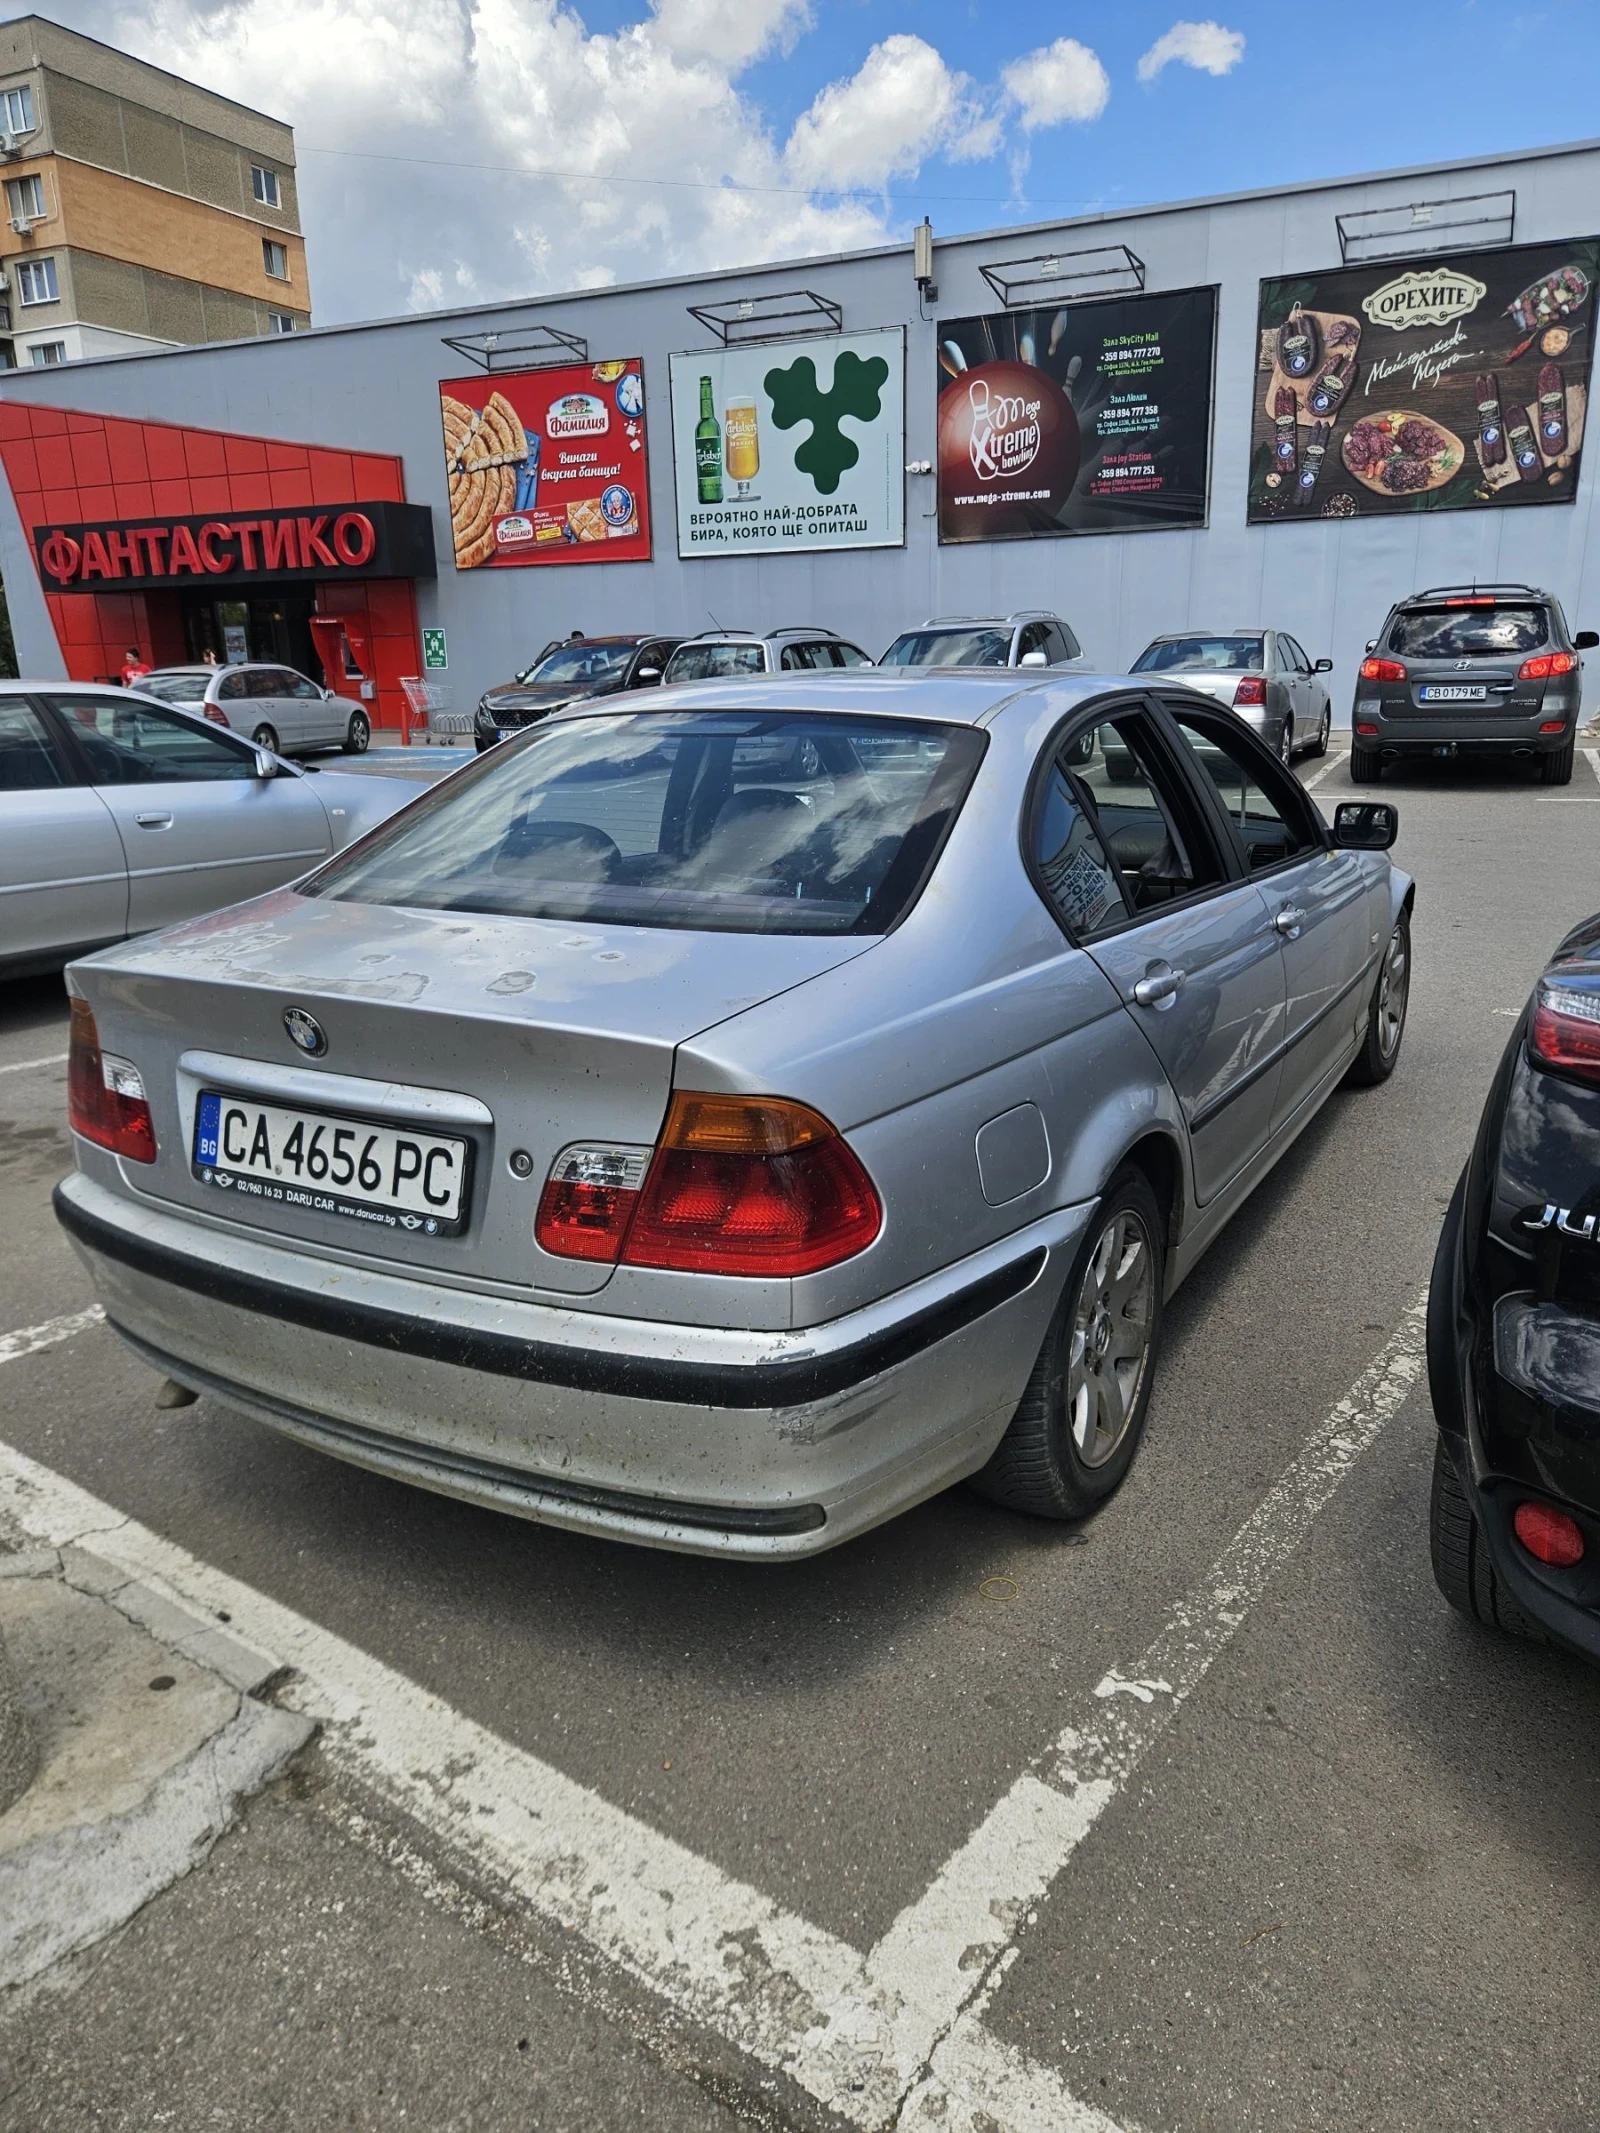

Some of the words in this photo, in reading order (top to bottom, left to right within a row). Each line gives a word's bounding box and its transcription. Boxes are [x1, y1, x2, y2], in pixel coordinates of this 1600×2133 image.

[1380, 287, 1467, 314] ОРЕХИТЕ
[1103, 338, 1118, 347] Зала
[1119, 335, 1144, 346] SkyCity
[1145, 332, 1159, 342] Mall
[1100, 351, 1118, 362] +359
[1118, 350, 1132, 360] 894
[1133, 348, 1146, 358] 777
[1147, 346, 1161, 357] 270
[1110, 394, 1126, 404] Зала
[1126, 393, 1148, 403] Люлин
[992, 395, 1040, 429] Mega
[1099, 409, 1115, 419] +359
[1116, 408, 1130, 418] 894
[1131, 406, 1144, 416] 777
[1145, 405, 1158, 415] 358
[550, 416, 605, 436] Фамилия
[559, 451, 598, 464] Винаги
[972, 425, 1036, 470] Xtreme
[1002, 447, 1033, 469] bowling
[1102, 455, 1117, 464] Зала
[1117, 454, 1128, 464] Joy
[1128, 452, 1152, 462] Station
[541, 468, 577, 483] вкусна
[578, 463, 621, 479] баница!
[1098, 468, 1114, 478] +359
[1115, 467, 1128, 477] 894
[1129, 466, 1143, 476] 777
[1143, 465, 1155, 475] 251
[954, 489, 1051, 505] www.mega-xtreme.com
[690, 510, 759, 525] ВЕРОЯТНО
[763, 503, 858, 521] НАЙ-ДОБРАТА
[691, 528, 728, 542] БИРА,
[733, 525, 777, 539] КОЯТО
[782, 523, 803, 537] ЩЕ
[808, 519, 868, 534] ОПИТАШ
[41, 512, 376, 586] ФАНТАСТИКО
[1427, 688, 1441, 698] CB
[1443, 688, 1468, 698] 0179
[1470, 688, 1484, 698] ME
[284, 1011, 316, 1028] BMW
[200, 1138, 217, 1156] BG
[223, 1108, 272, 1169] CA
[282, 1121, 381, 1191] 4656
[391, 1139, 453, 1206] PC
[237, 1180, 262, 1195] 02/960
[264, 1187, 272, 1197] 16
[273, 1188, 283, 1199] 23
[286, 1191, 313, 1206] DARU
[314, 1197, 335, 1211] CAR
[338, 1204, 397, 1227] www.darucar.bg
[1522, 1204, 1600, 1243] JU
